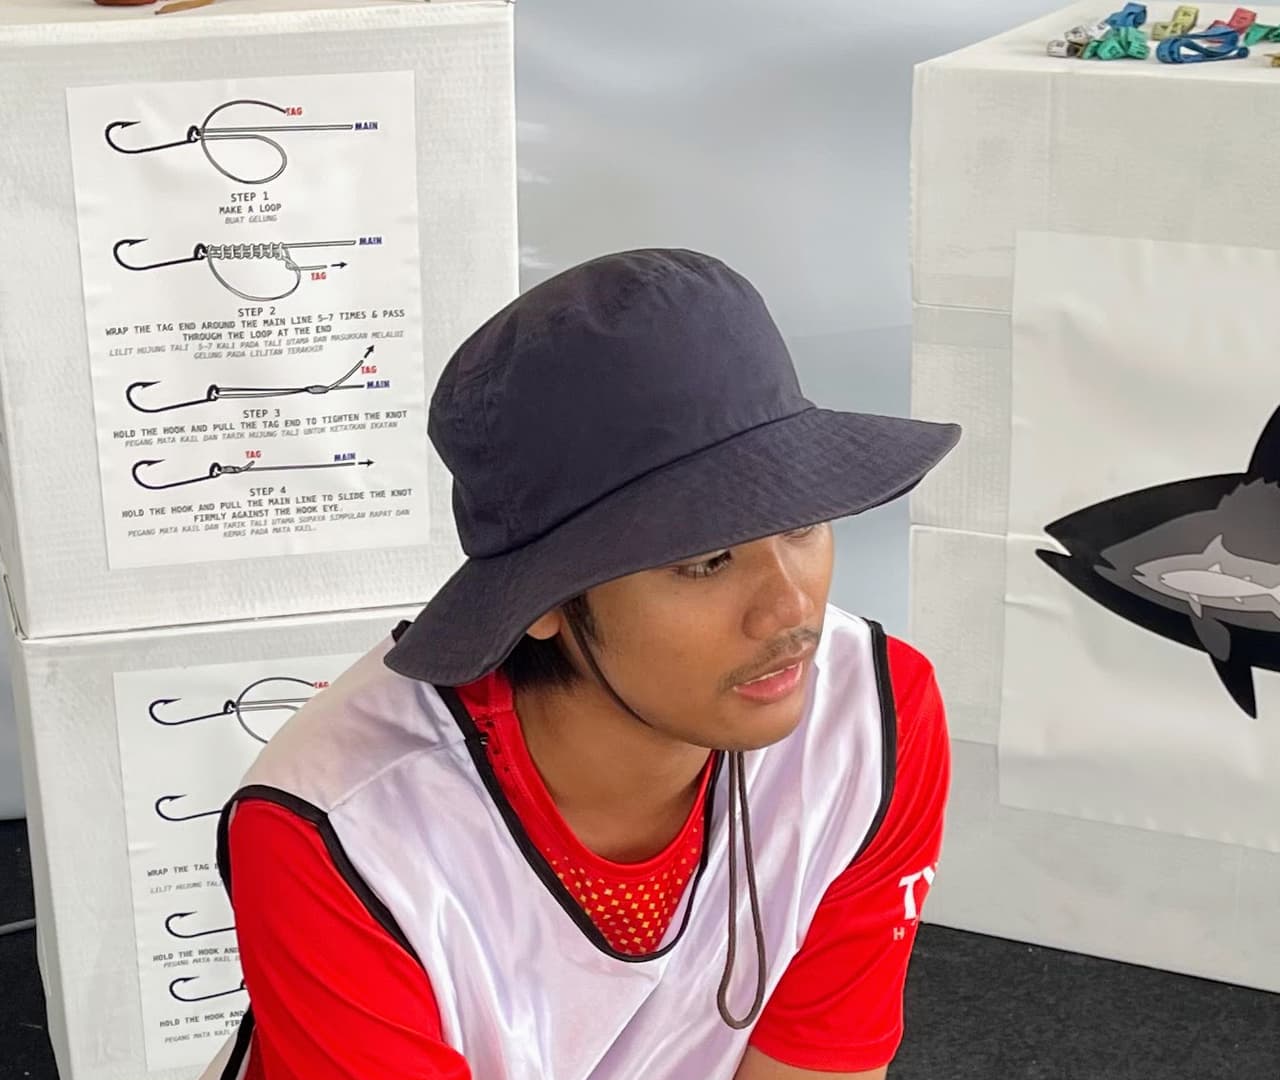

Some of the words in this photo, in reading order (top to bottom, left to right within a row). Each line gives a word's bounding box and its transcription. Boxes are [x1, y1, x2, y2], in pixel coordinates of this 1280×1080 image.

[286, 107, 303, 116] TAG
[355, 122, 378, 130] MAIN
[231, 192, 256, 202] STEP
[264, 191, 269, 200] 1
[219, 206, 242, 214] MAKE
[248, 205, 253, 213] A
[260, 203, 281, 212] LOOP
[359, 237, 382, 245] MAIN
[311, 272, 326, 280] TAG
[238, 307, 263, 317] STEP
[270, 307, 275, 315] 2
[105, 327, 128, 336] WRAP
[134, 325, 150, 333] THE
[157, 324, 173, 332] TAG
[179, 322, 196, 330] END
[202, 321, 235, 329] AROUND
[242, 320, 257, 328] THE
[263, 318, 285, 326] MAIN
[291, 316, 312, 324] LINE
[340, 311, 366, 320] TIMES
[383, 309, 405, 318] PASS
[183, 332, 222, 341] THROUGH
[229, 331, 244, 339] THE
[250, 330, 272, 339] LOOP
[295, 327, 310, 335] THE
[316, 325, 331, 333] END
[361, 366, 377, 374] TAG
[366, 380, 390, 388] MAIN
[243, 409, 268, 418] STEP
[275, 409, 280, 417] 3
[113, 430, 135, 438] HOLD
[142, 428, 157, 436] THE
[163, 426, 185, 434] HOOK
[191, 424, 207, 432] AND
[213, 423, 235, 431] PULL
[241, 421, 257, 429] THE
[262, 420, 279, 428] TAG
[285, 419, 301, 427] END
[322, 414, 359, 424] TIGHTEN
[245, 450, 261, 458] TAG
[334, 453, 356, 461] MAIN
[250, 487, 274, 496] STEP
[280, 486, 286, 494] 4
[122, 509, 144, 518] HOLD
[149, 507, 166, 515] THE
[171, 505, 193, 514] HOOK
[220, 501, 242, 509] PULL
[248, 499, 264, 507] THE
[269, 497, 290, 505] MAIN
[296, 495, 316, 504] LINE
[338, 492, 364, 500] SLIDE
[370, 490, 386, 498] THE
[194, 513, 226, 522] FIRMLY
[232, 509, 269, 519] AGAINST
[276, 508, 291, 516] THE
[296, 506, 317, 514] HOOK
